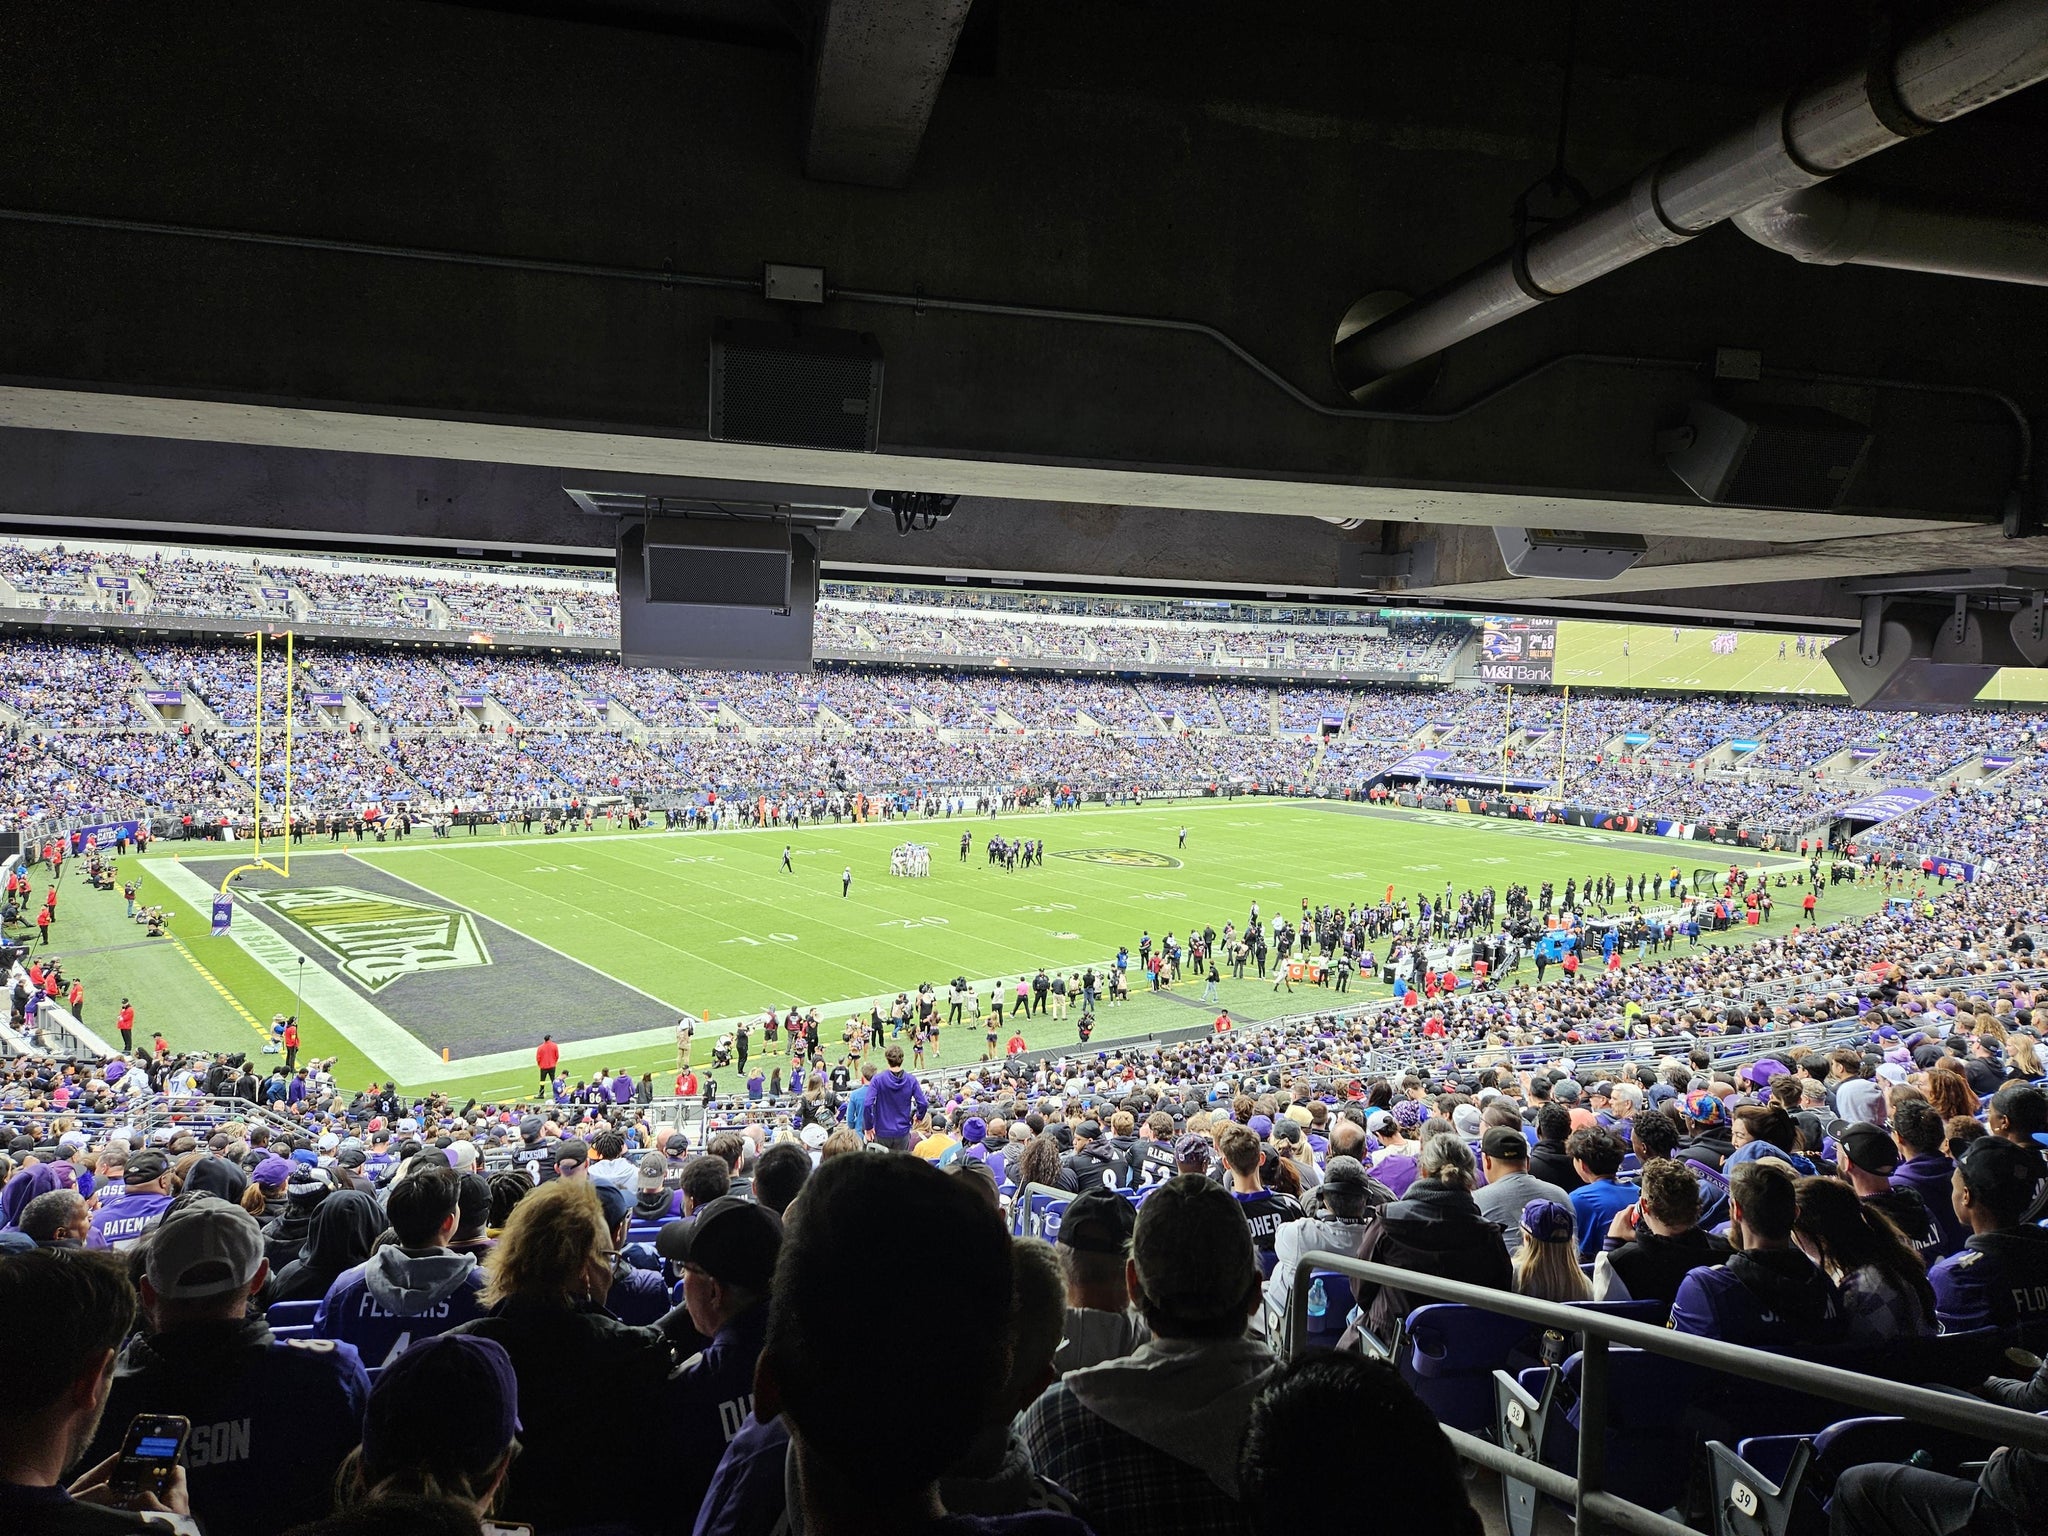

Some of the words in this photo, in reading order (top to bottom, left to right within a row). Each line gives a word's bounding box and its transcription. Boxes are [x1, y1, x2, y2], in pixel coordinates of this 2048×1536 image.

[1482, 664, 1516, 679] M&T
[1517, 666, 1551, 681] Bank
[892, 915, 950, 930] 20
[734, 931, 799, 947] 10
[589, 1092, 602, 1104] 86
[518, 1147, 548, 1162] JACKSON
[1147, 1146, 1174, 1164] R.LEWIS
[1138, 1159, 1172, 1190] 52
[1706, 1174, 1732, 1193] RAVE
[2011, 1286, 2048, 1313] FLO
[1511, 1406, 1521, 1421] 38
[1736, 1489, 1751, 1508] 39
